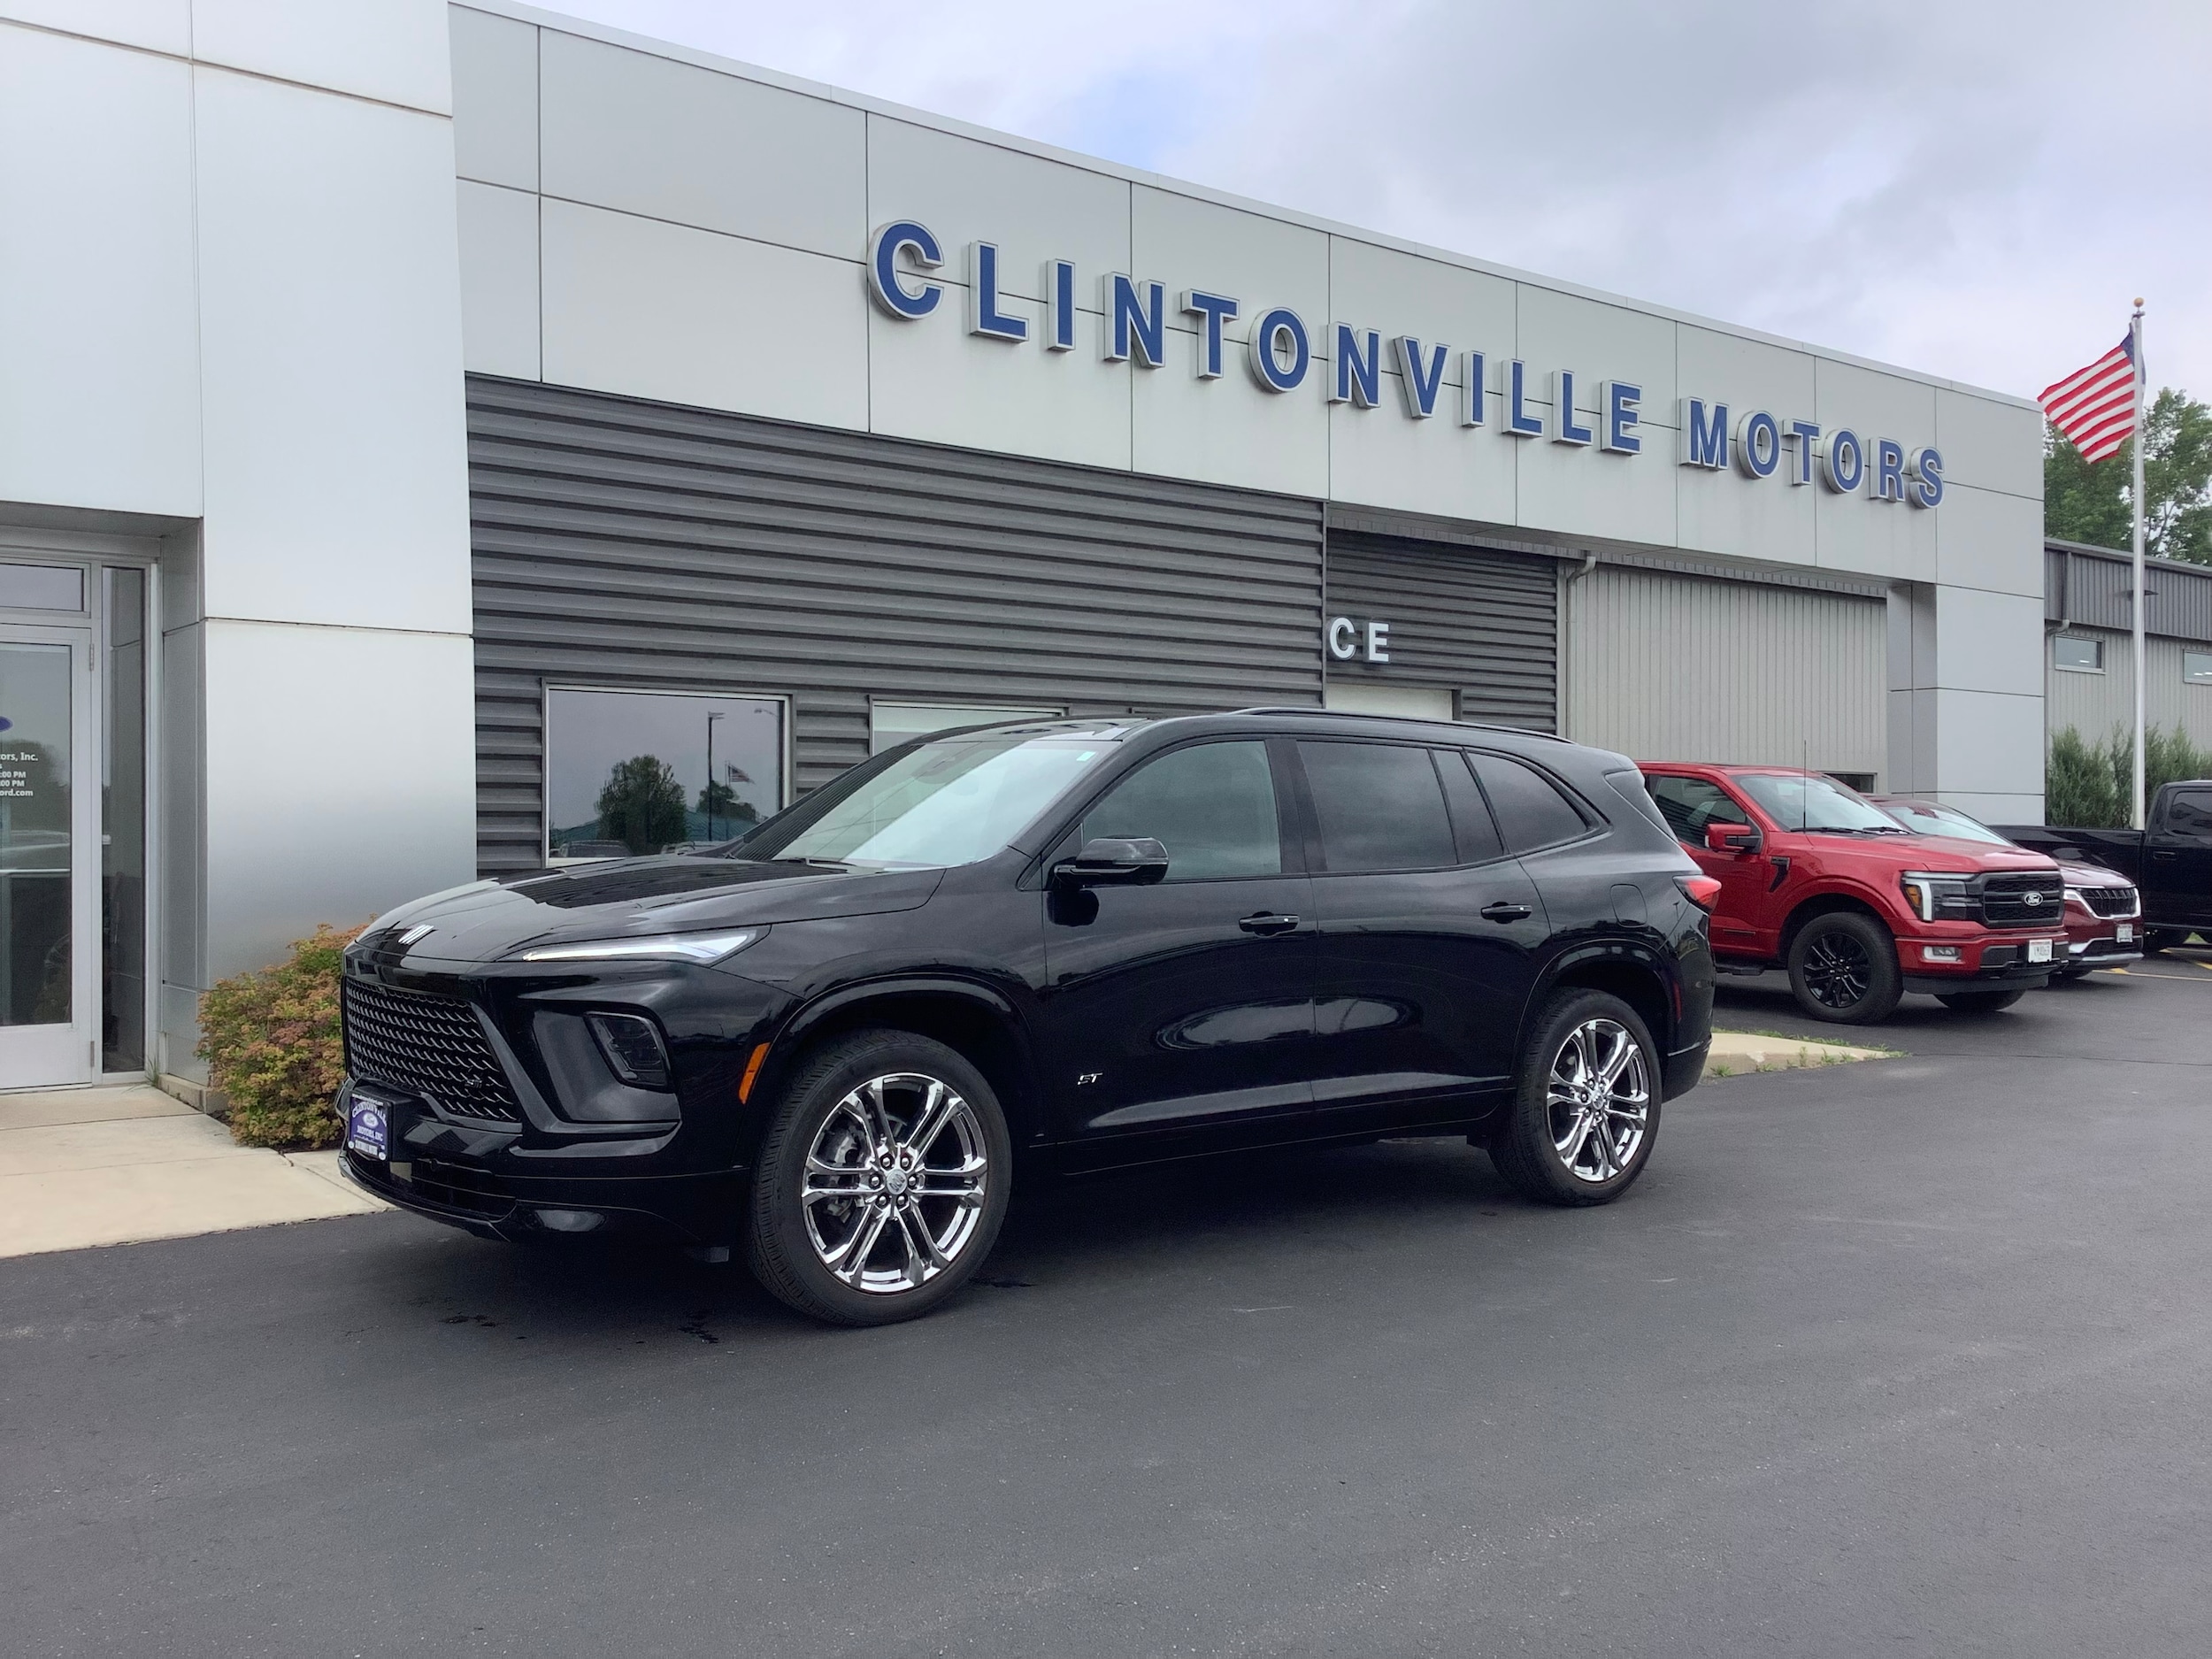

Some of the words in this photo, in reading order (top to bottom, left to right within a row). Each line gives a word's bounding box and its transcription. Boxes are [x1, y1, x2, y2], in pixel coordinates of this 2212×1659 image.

[868, 219, 1642, 457] CLINTONVILLE
[1680, 396, 1947, 510] MOTORS
[1329, 617, 1389, 663] CE
[20, 751, 38, 761] Inc.
